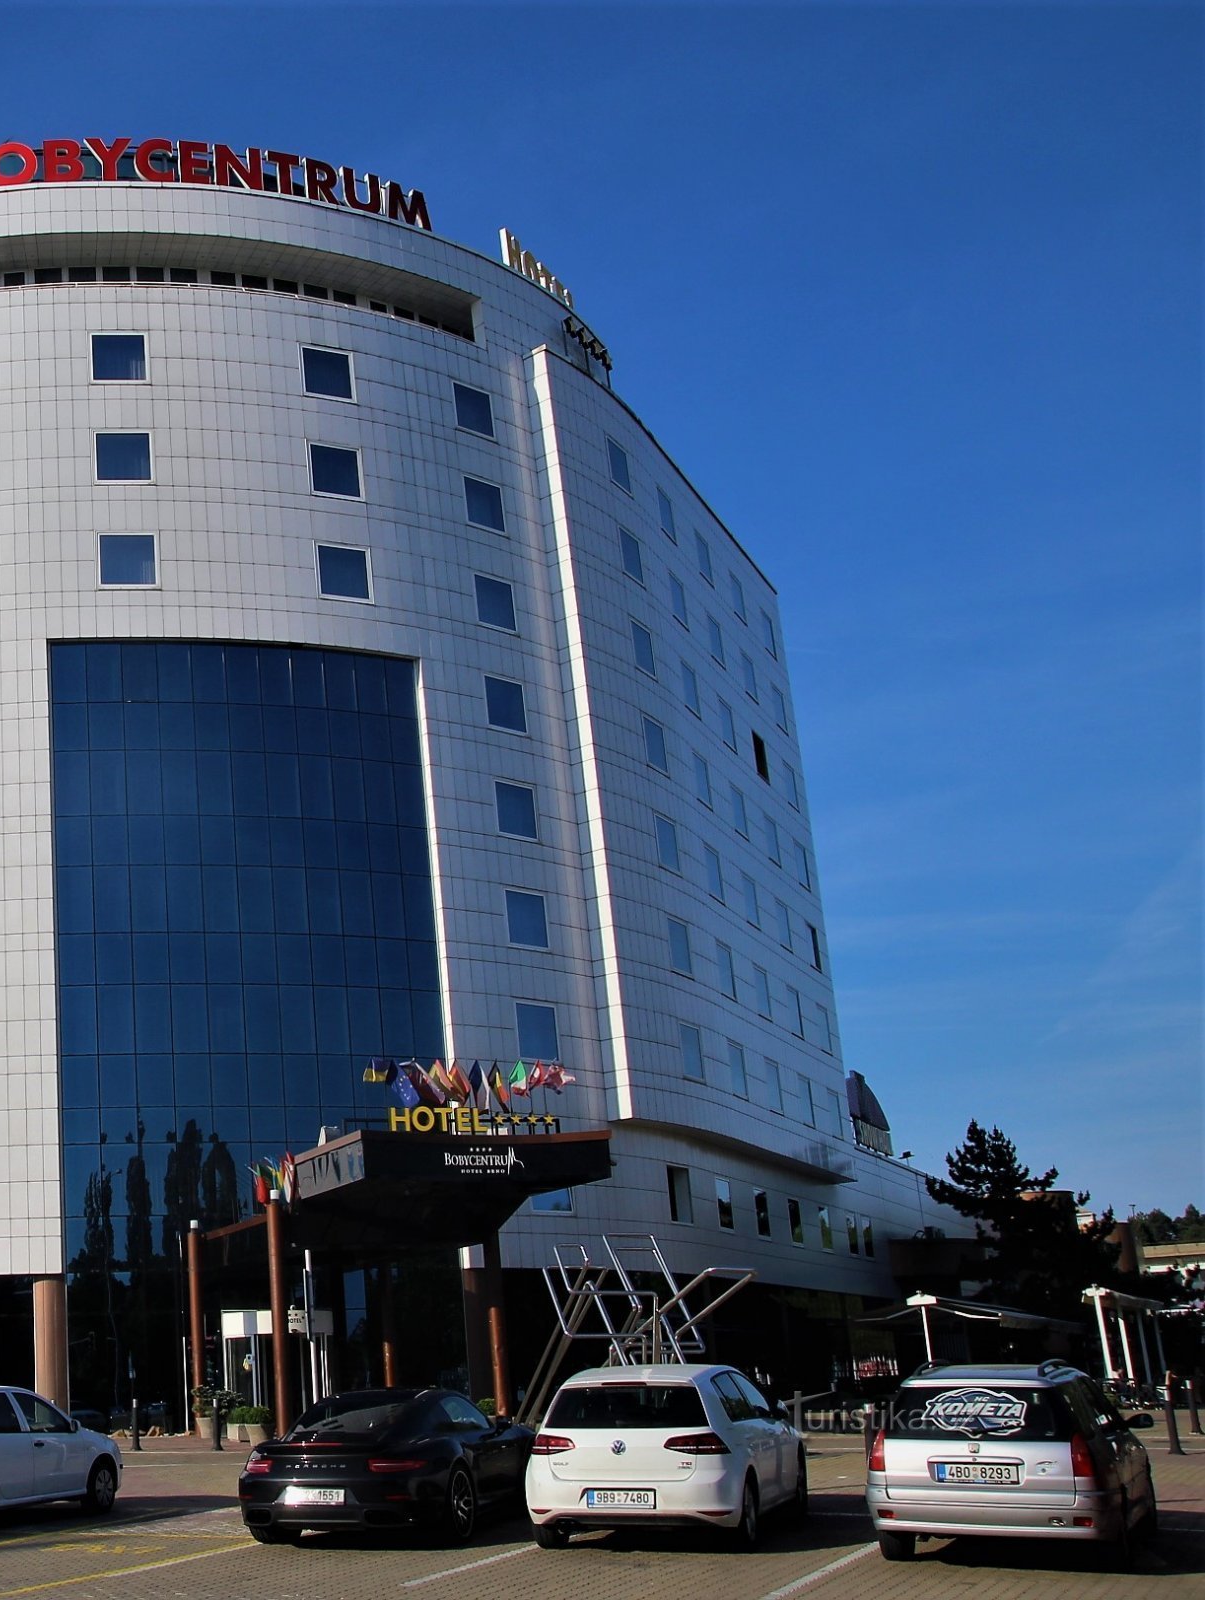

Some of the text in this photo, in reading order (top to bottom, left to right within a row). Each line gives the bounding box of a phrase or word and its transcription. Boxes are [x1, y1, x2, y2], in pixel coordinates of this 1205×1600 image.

[390, 1105, 489, 1132] HOTEL
[929, 1402, 1022, 1417] KOMETA
[979, 1466, 1012, 1480] 8293
[596, 1492, 650, 1504] 9B9 7480
